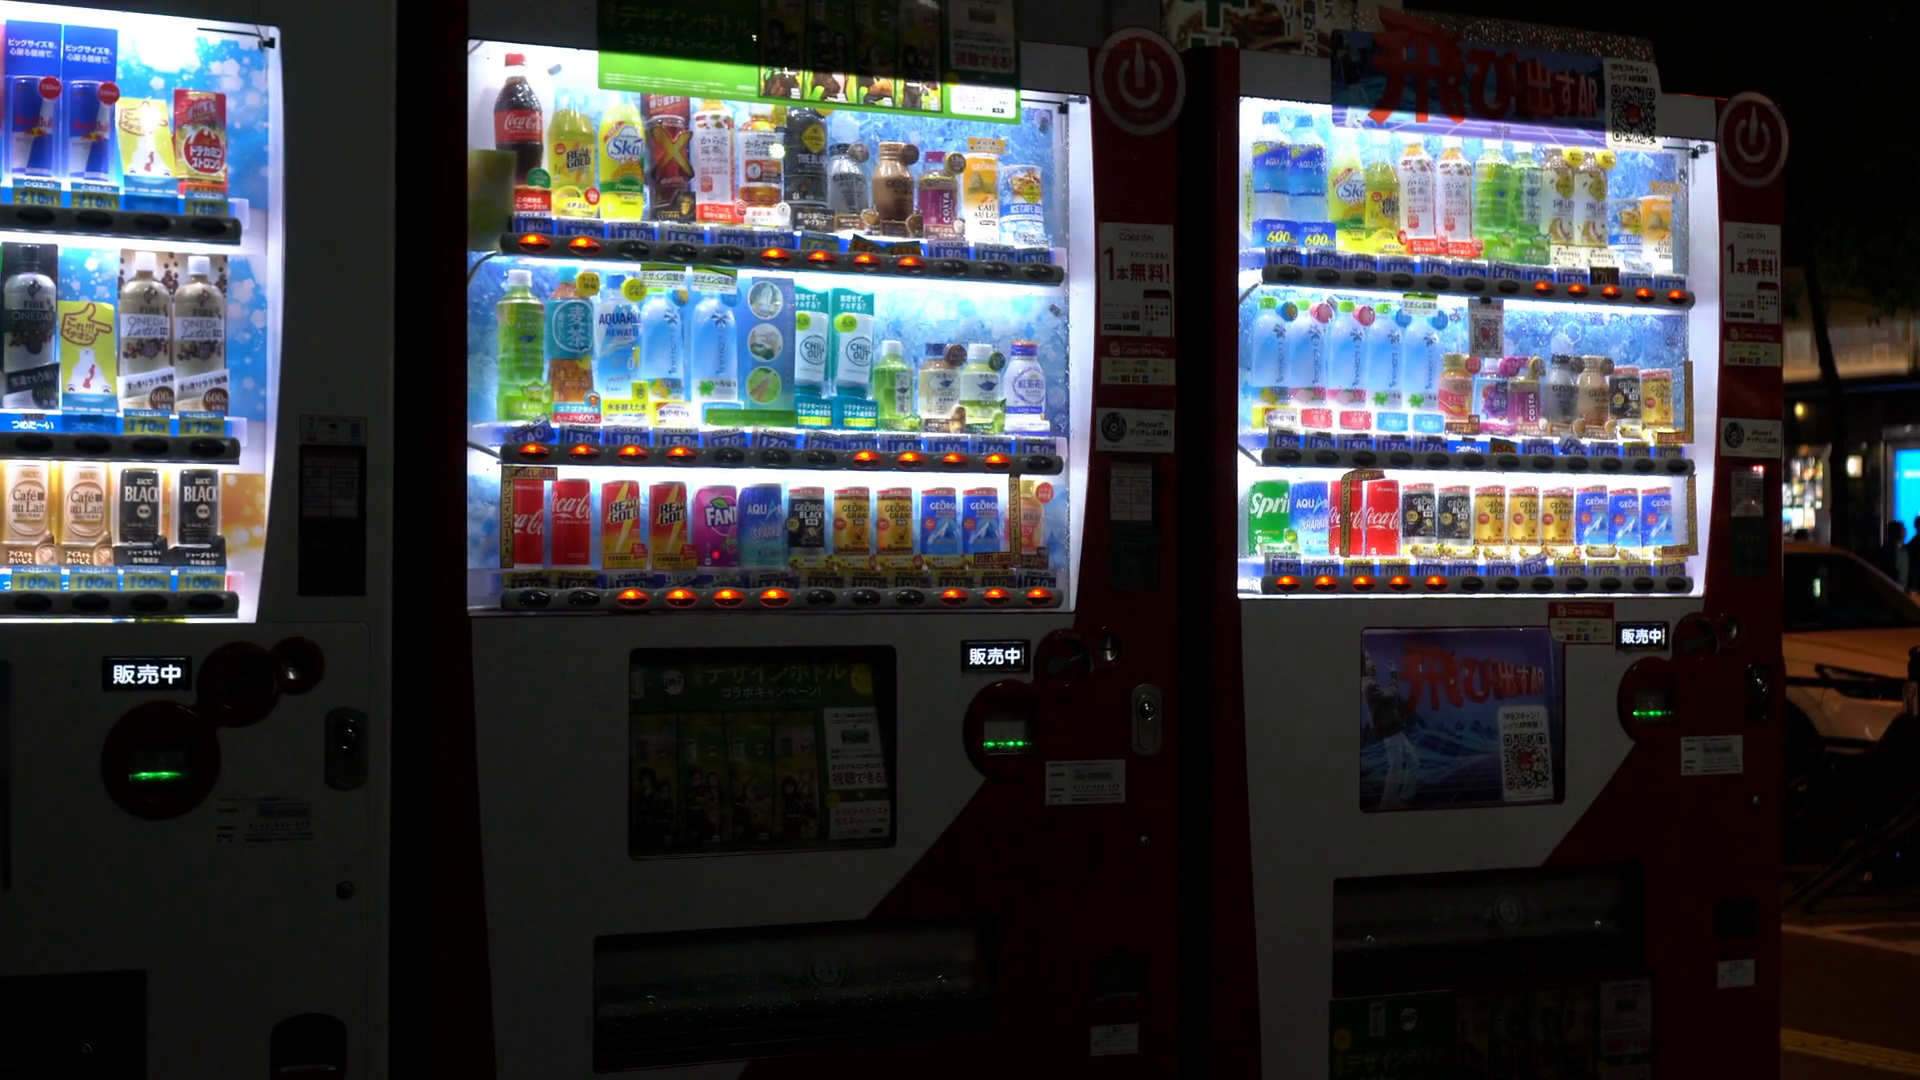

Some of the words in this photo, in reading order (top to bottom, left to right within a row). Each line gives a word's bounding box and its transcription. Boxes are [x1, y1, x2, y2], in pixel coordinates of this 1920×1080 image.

[567, 304, 586, 347] 麦茶
[807, 350, 823, 359] OUT
[853, 351, 869, 361] OUT
[13, 489, 36, 501] Café
[70, 490, 94, 503] Café
[125, 486, 158, 502] BLACK
[183, 486, 217, 502] BLACK
[12, 503, 24, 513] au
[70, 505, 82, 514] au
[1621, 628, 1662, 645] 販売中
[969, 647, 1021, 665] 販売中
[113, 664, 182, 685] 販売中
